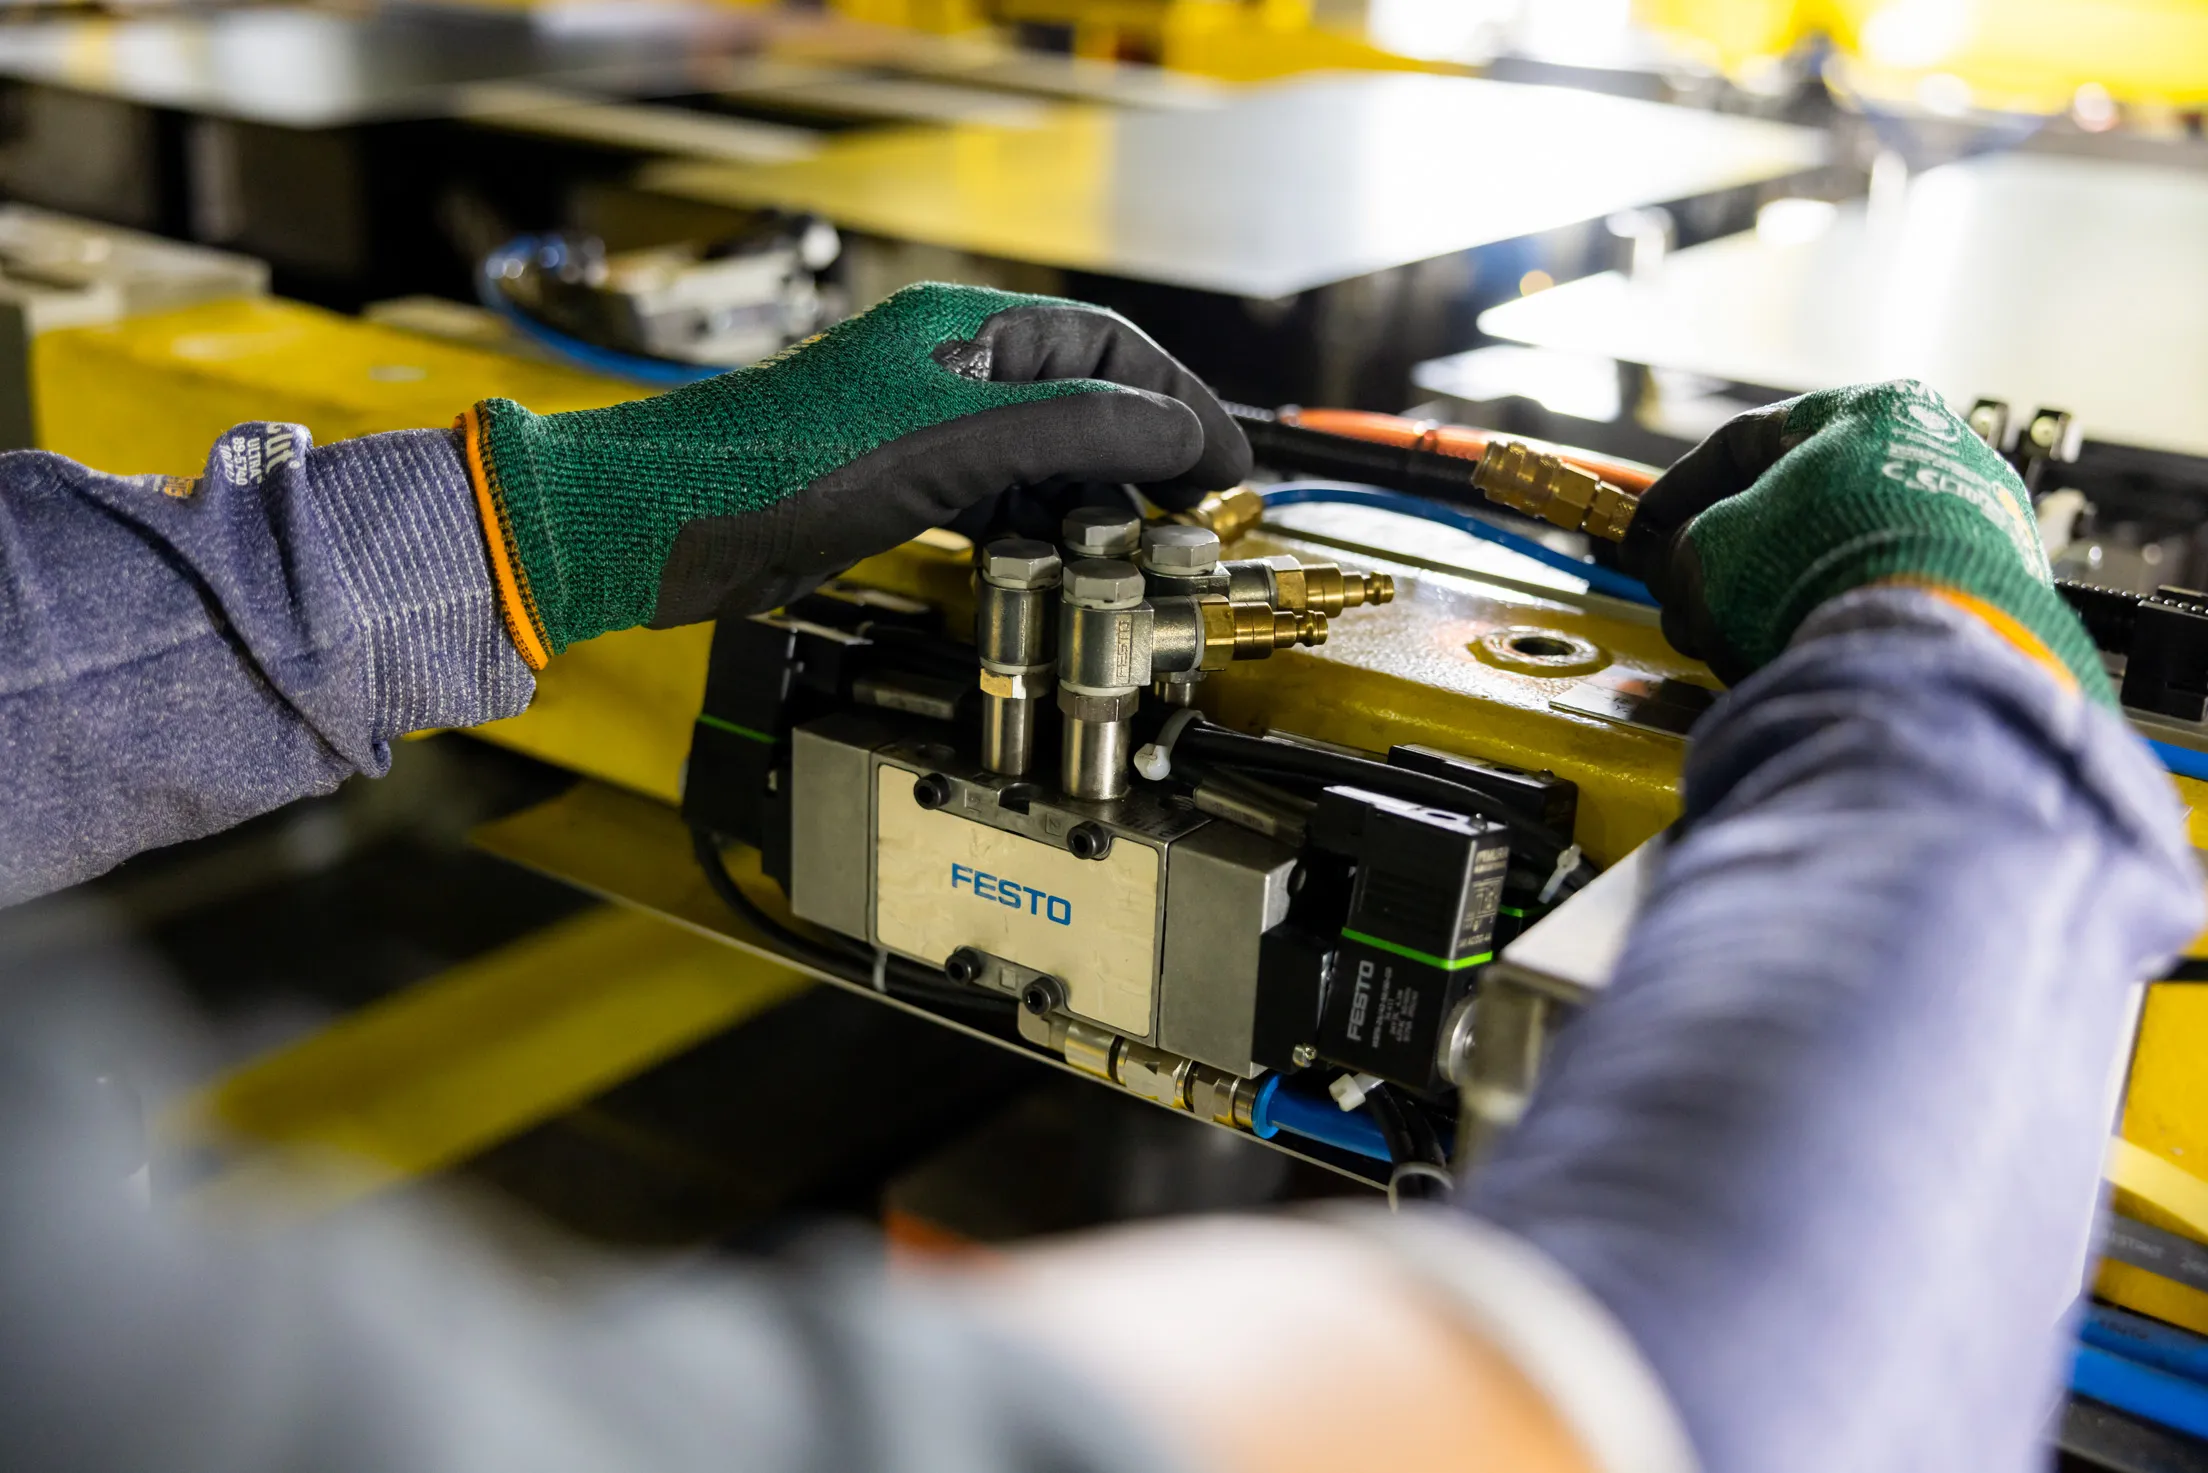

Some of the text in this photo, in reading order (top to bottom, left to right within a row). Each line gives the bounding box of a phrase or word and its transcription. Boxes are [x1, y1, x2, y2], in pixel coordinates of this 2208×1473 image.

[232, 436, 248, 486] 89-5740
[1116, 620, 1130, 678] FESTO
[951, 862, 1072, 927] FESTO
[1347, 960, 1375, 1041] FESTO
